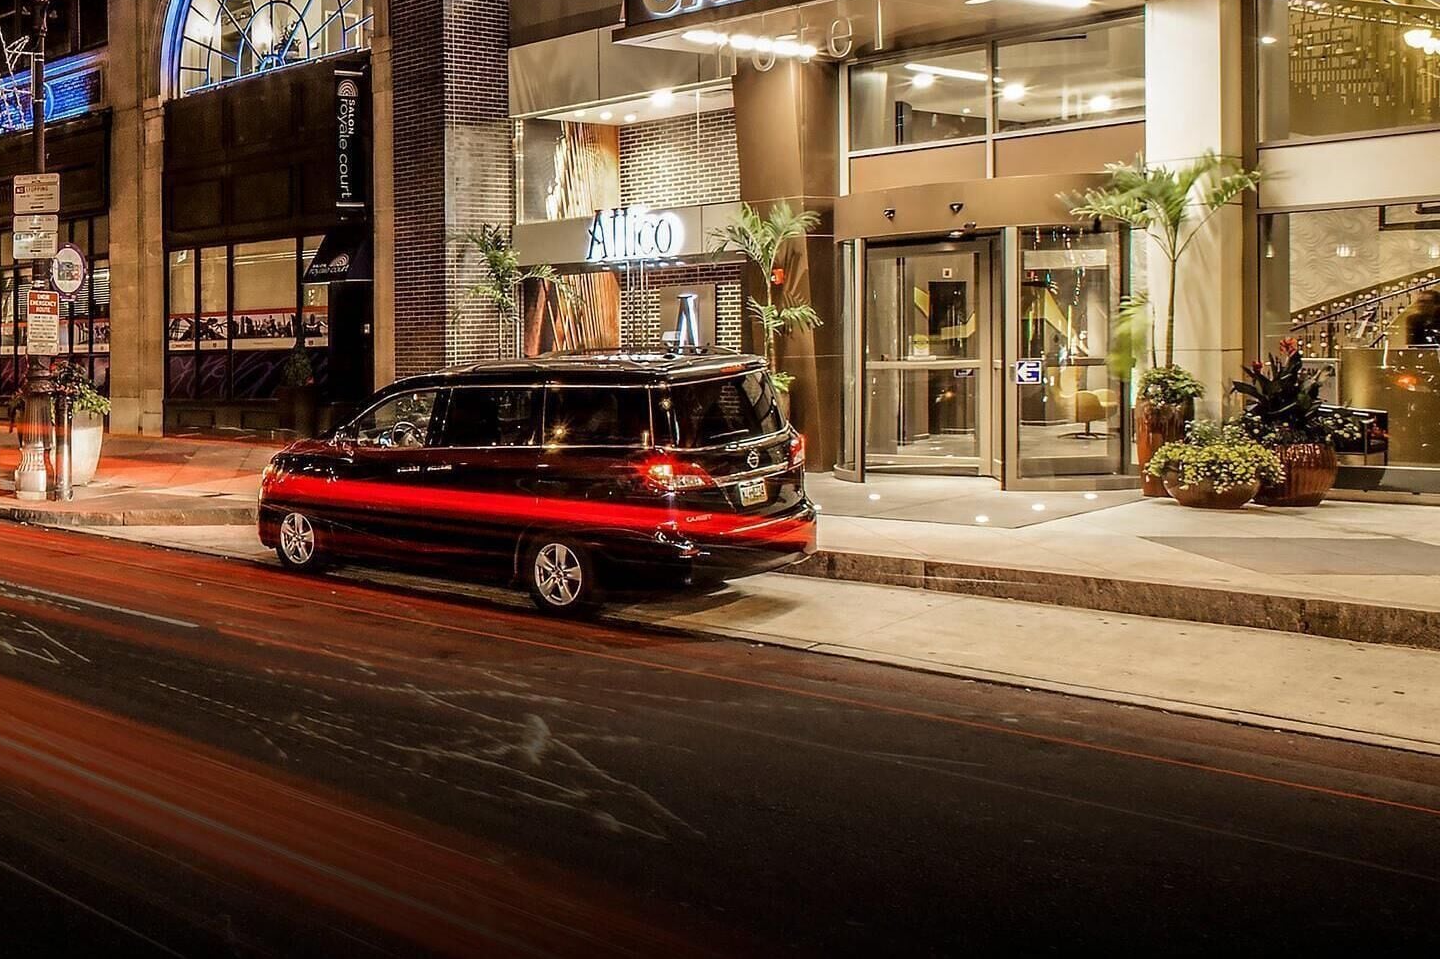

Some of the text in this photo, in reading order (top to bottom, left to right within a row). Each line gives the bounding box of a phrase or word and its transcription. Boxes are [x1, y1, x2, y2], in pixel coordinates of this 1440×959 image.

[336, 98, 352, 199] royale court
[348, 99, 356, 135] SALON
